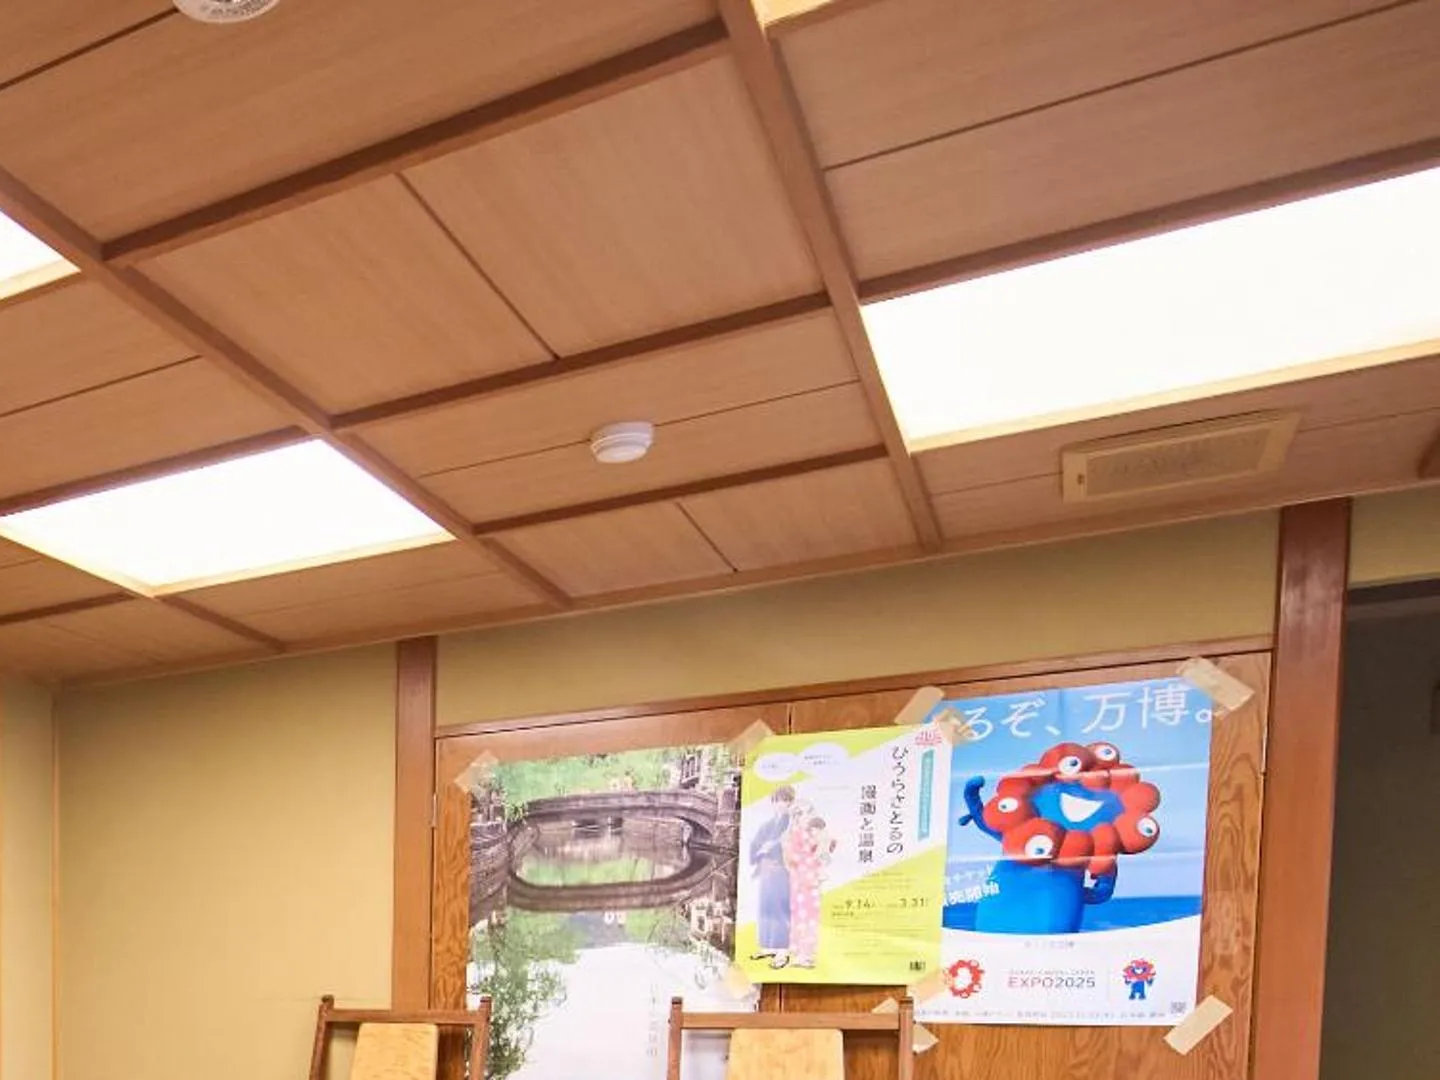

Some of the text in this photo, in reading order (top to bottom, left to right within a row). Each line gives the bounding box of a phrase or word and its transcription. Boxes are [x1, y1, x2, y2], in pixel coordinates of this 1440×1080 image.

[886, 746, 910, 854] ひうらさとるの
[1008, 976, 1096, 989] EXPO2025
